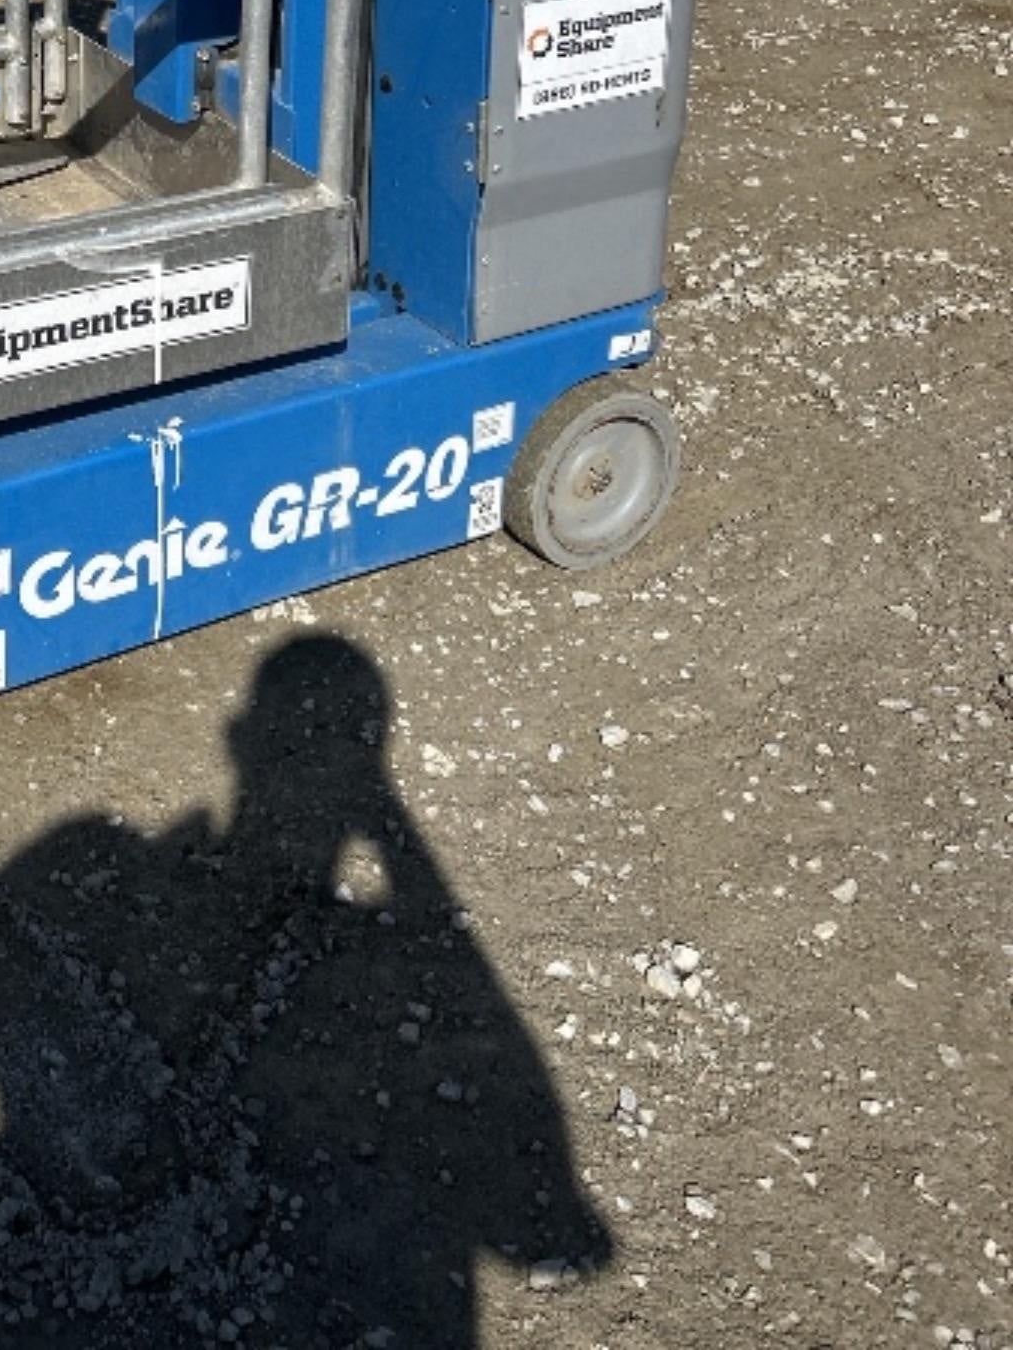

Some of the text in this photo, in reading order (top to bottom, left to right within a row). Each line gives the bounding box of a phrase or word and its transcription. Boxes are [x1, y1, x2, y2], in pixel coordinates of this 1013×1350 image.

[559, 1, 664, 37] Equipment
[556, 35, 616, 58] Share
[19, 434, 470, 619] Genie GR-20
